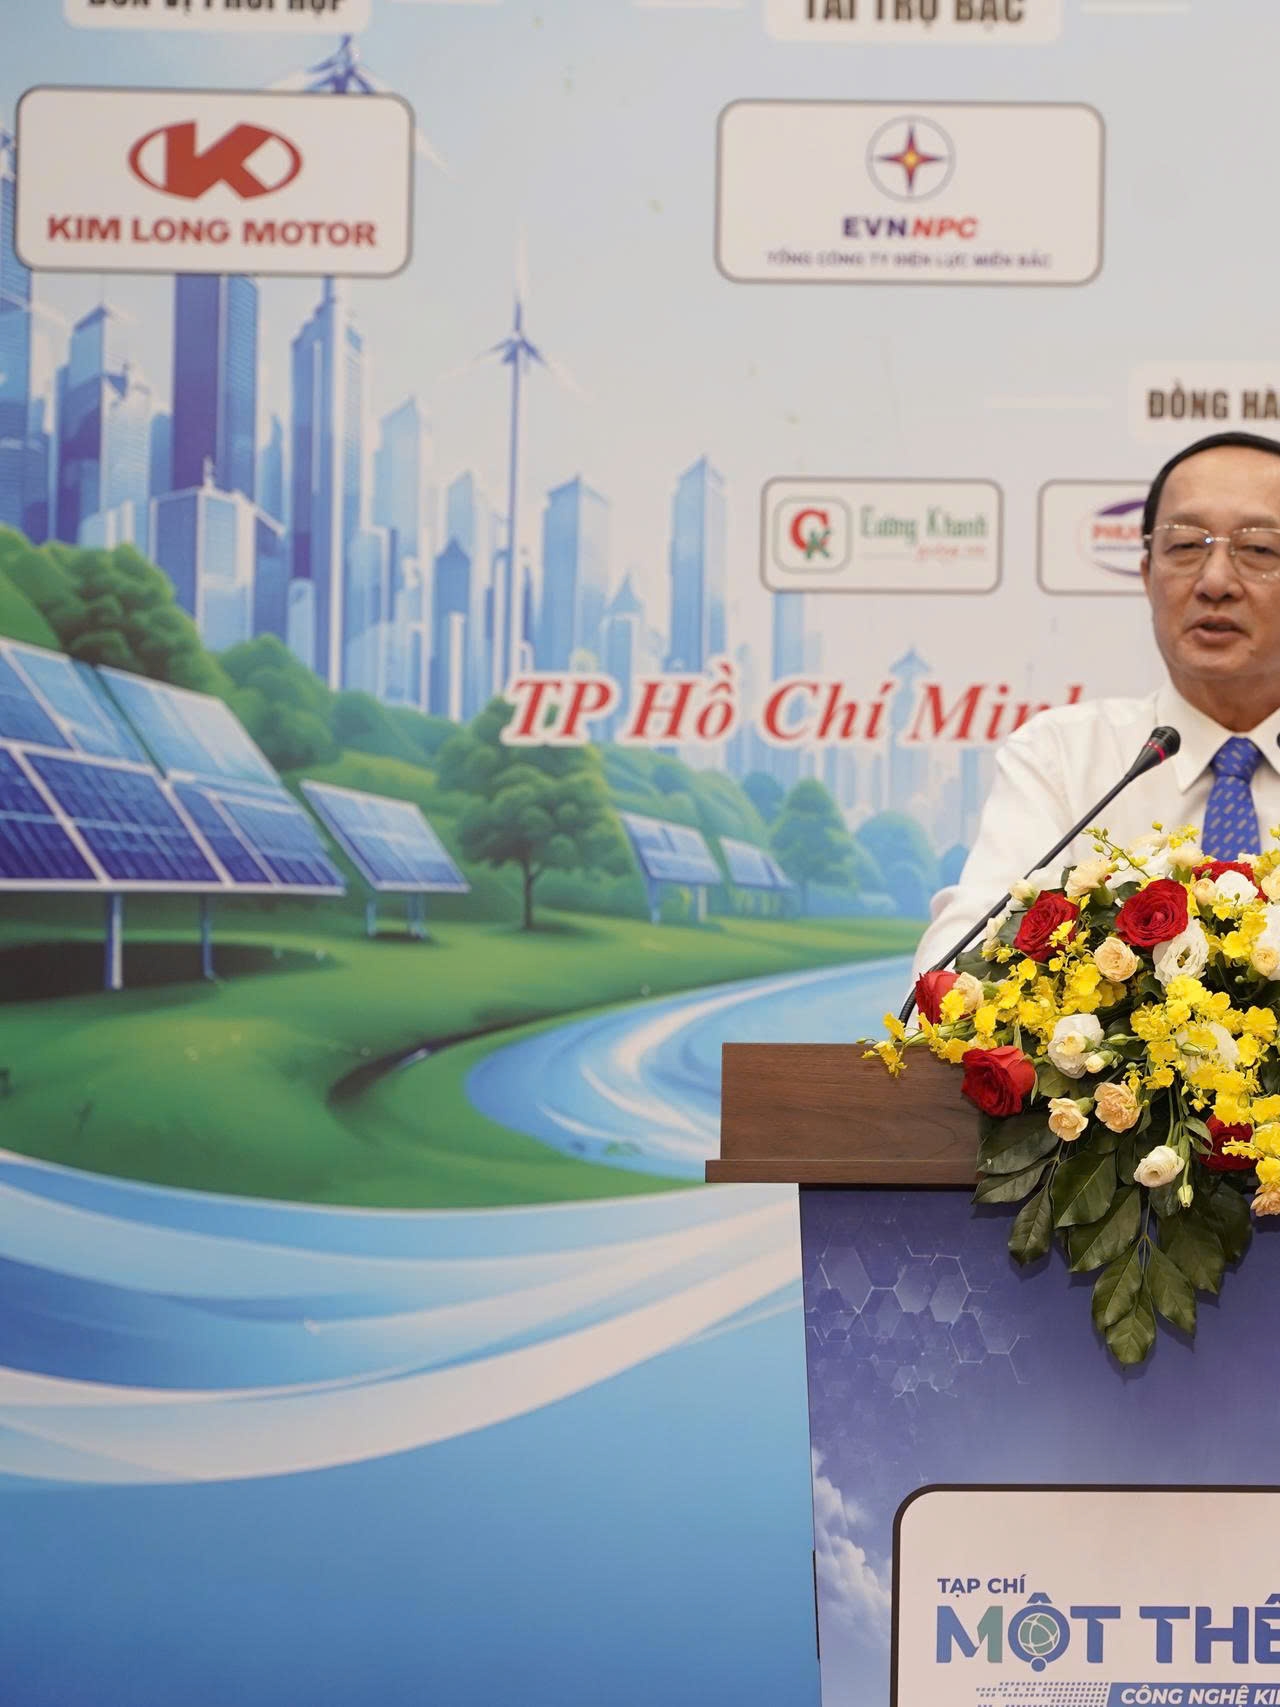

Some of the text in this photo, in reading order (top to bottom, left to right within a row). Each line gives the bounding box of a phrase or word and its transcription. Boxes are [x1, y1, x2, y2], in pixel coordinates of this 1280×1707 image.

[48, 217, 376, 246] KIM LONG MOTOR
[1146, 378, 1229, 420] ĐỒNG
[514, 680, 612, 738] TP
[630, 662, 735, 739] Hồ
[762, 681, 894, 741] Chí
[937, 1574, 1026, 1598] TẠP CHÍ
[936, 1592, 1121, 1672] MỘT
[1121, 1685, 1184, 1705] CÔNG
[1188, 1685, 1249, 1707] NGHỆ
